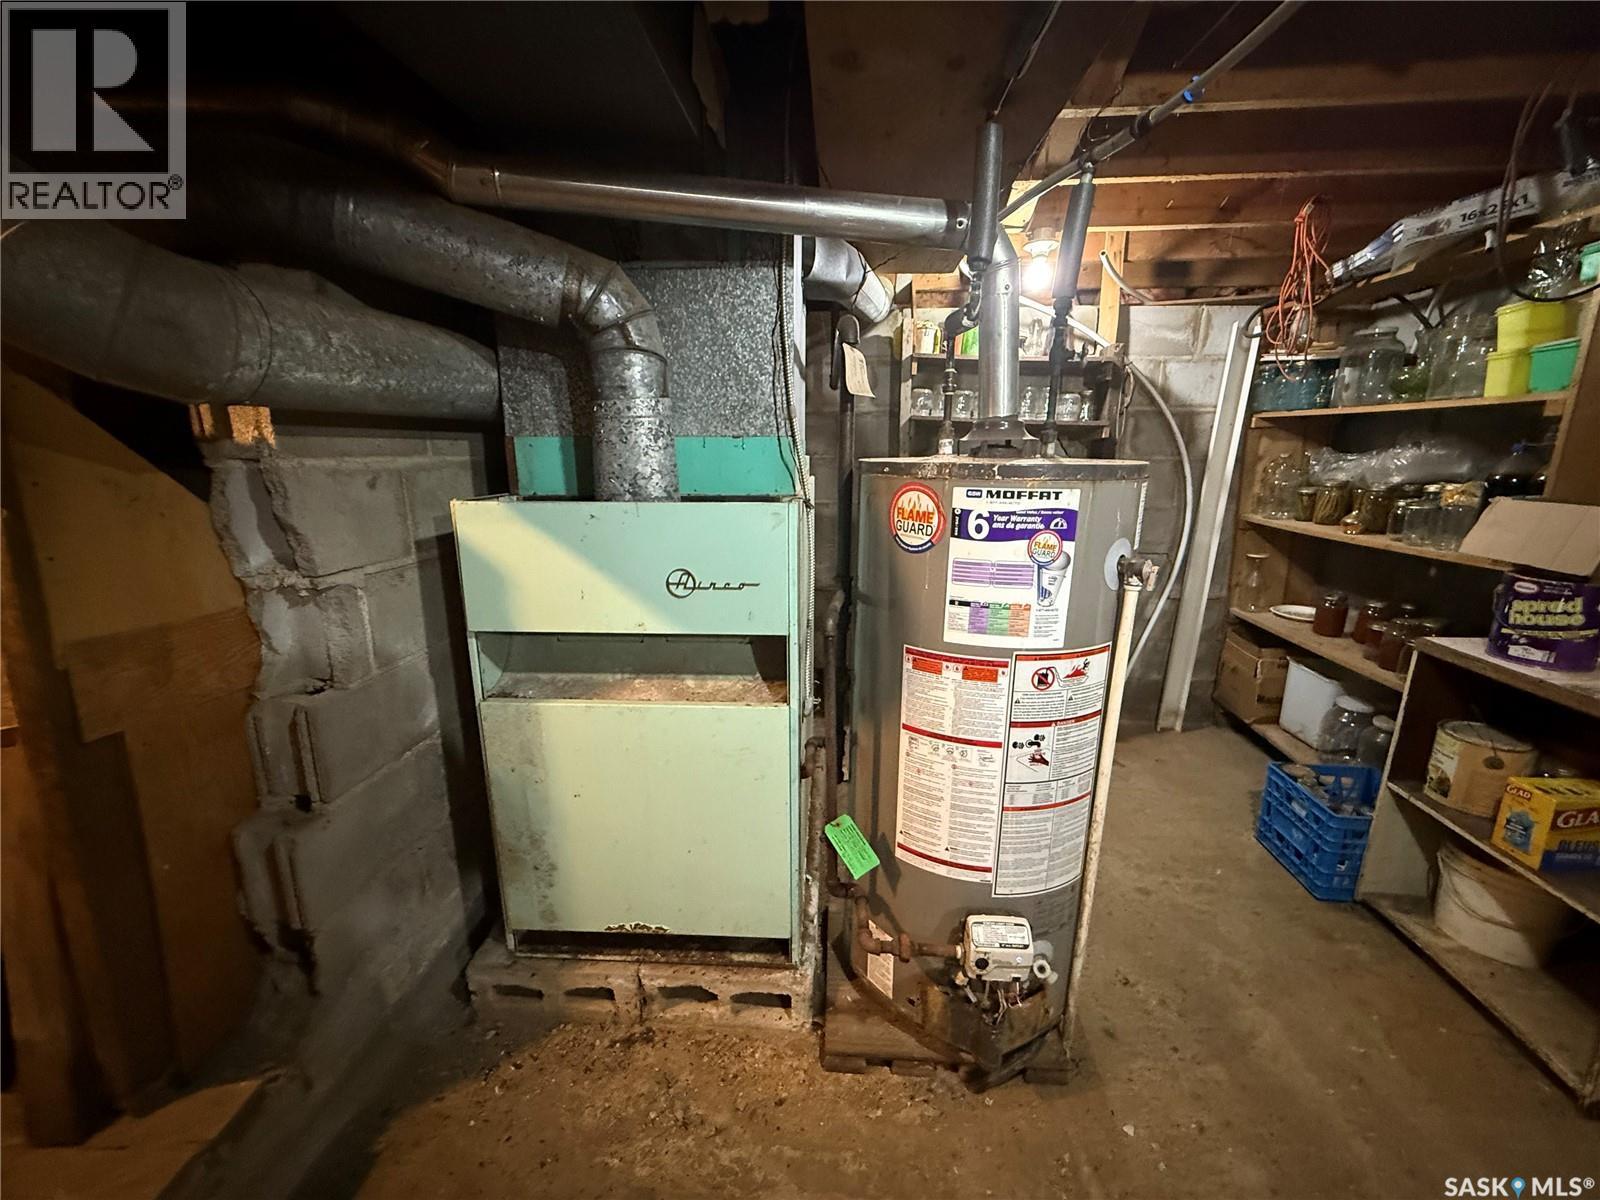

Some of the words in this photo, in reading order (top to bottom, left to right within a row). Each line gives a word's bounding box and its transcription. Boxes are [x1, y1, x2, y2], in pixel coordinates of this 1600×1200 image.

[986, 490, 1063, 500] MOFFAT
[896, 507, 935, 524] FLAME
[993, 514, 1009, 523] Year
[1010, 514, 1043, 525] Warranty
[896, 520, 934, 537] GUARD
[967, 509, 990, 540] 6
[1015, 523, 1046, 531] garantie
[1032, 548, 1056, 557] GUARD
[1033, 541, 1058, 551] FLAME
[1508, 610, 1586, 626] house
[1506, 784, 1531, 799] GLAD
